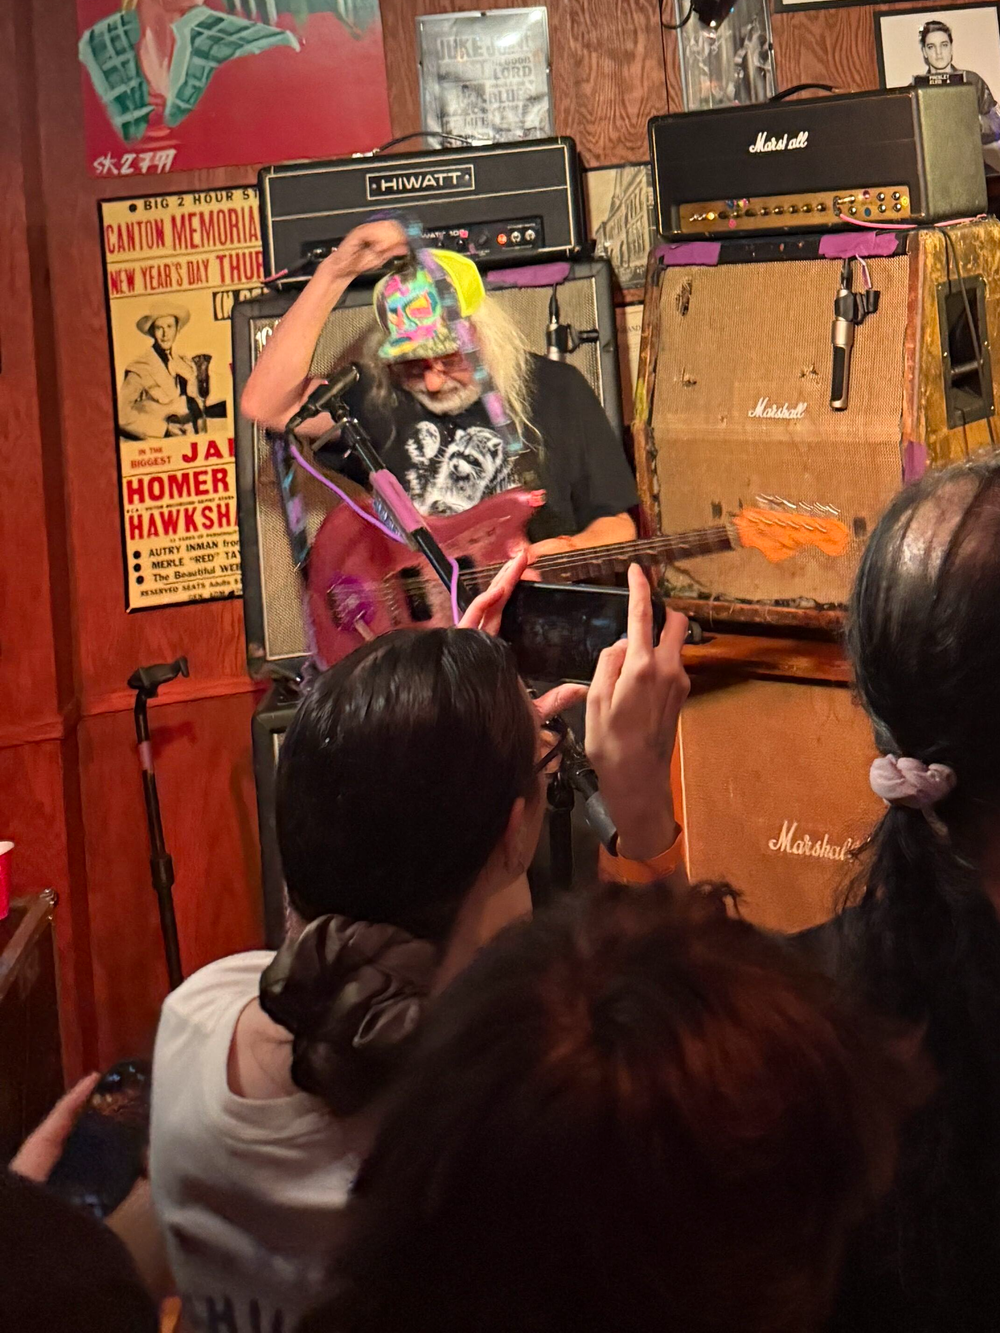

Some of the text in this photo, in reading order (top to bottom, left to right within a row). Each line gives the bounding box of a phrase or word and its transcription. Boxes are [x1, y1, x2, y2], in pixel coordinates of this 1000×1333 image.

[493, 65, 533, 80] LORD
[381, 171, 462, 192] HIWATT
[144, 199, 169, 211] BIG
[178, 197, 185, 207] 2
[193, 191, 234, 205] HOUR
[105, 206, 260, 254] CANTON MEMORIA
[109, 268, 136, 296] NEW
[140, 262, 183, 291] YEAR'S
[187, 259, 211, 285] DAY
[748, 396, 808, 419] Marshall
[149, 446, 163, 454] THE
[131, 455, 172, 468] BIGGEST
[126, 468, 230, 505] HOMER
[128, 503, 238, 540] HAWKSH
[149, 546, 181, 558] AUTRY
[186, 541, 219, 552] INMAN
[152, 558, 185, 570] MERLE
[153, 574, 169, 583] The
[174, 566, 216, 580] Beautiful
